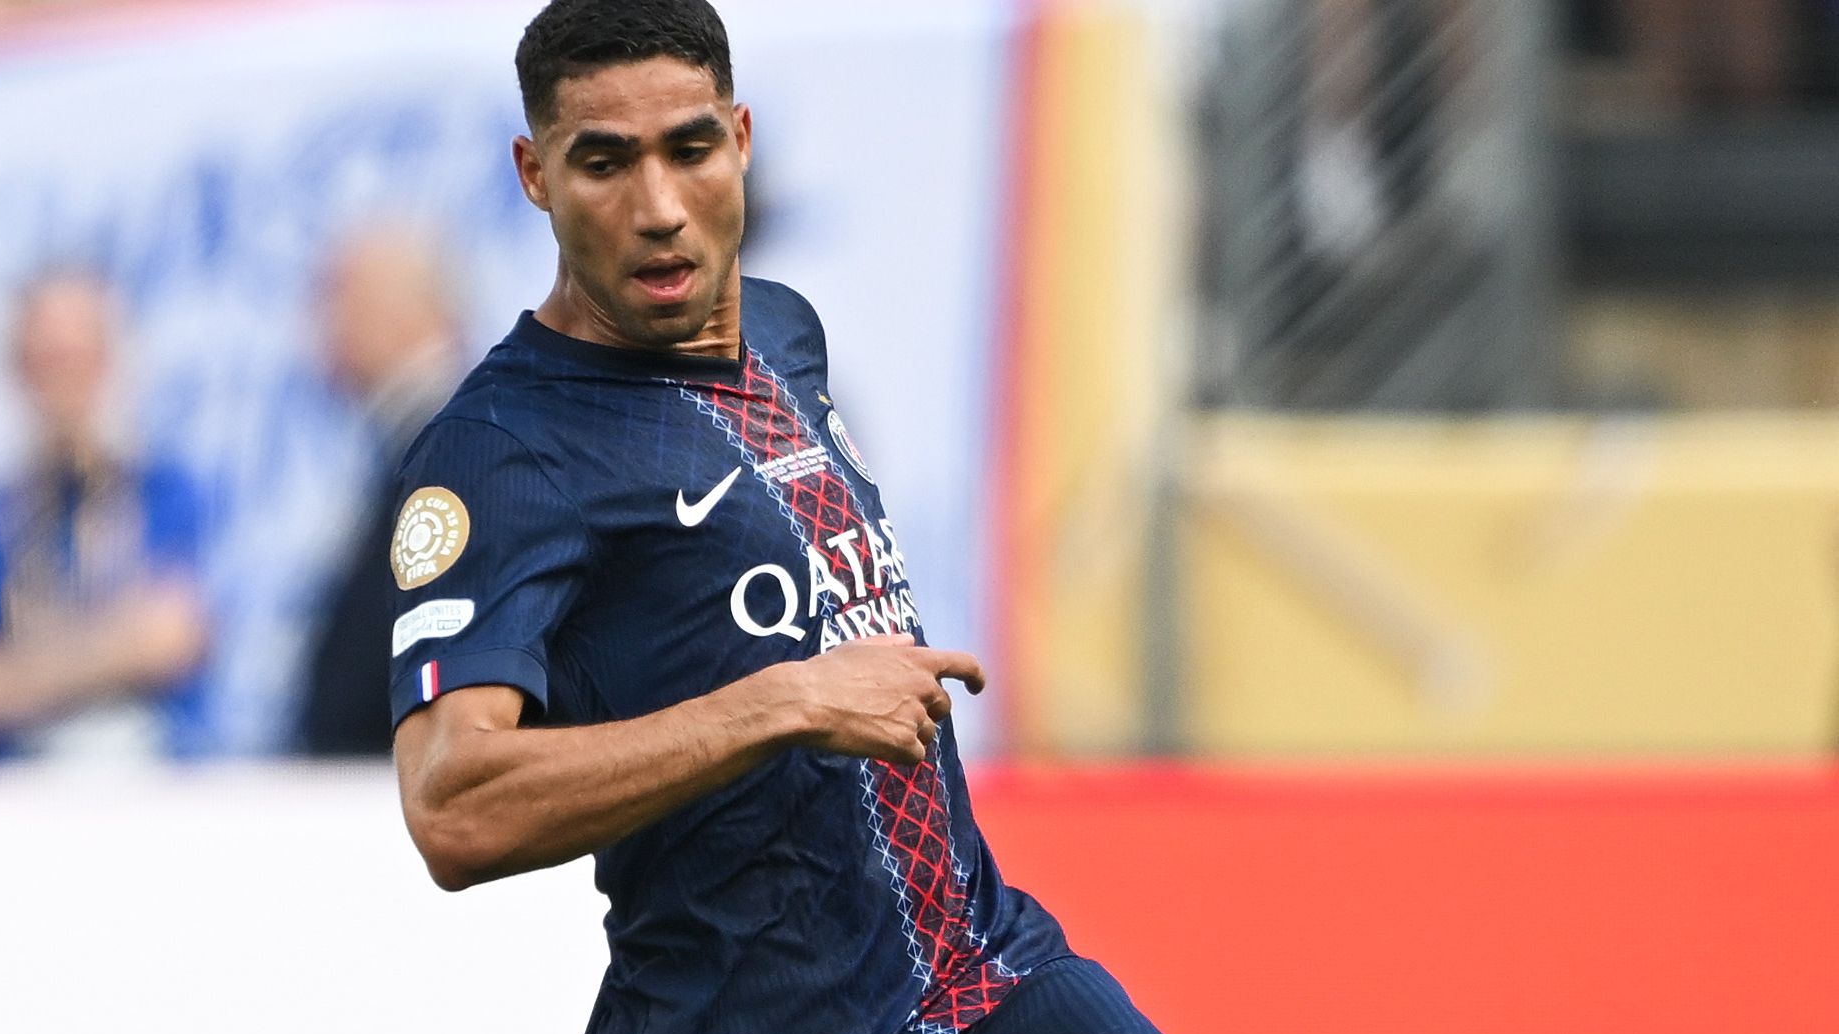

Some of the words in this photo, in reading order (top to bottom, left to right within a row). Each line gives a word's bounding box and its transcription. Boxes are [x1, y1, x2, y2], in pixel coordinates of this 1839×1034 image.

[425, 497, 450, 511] CUP
[406, 559, 438, 584] FIFA
[820, 588, 921, 655] AIRWA
